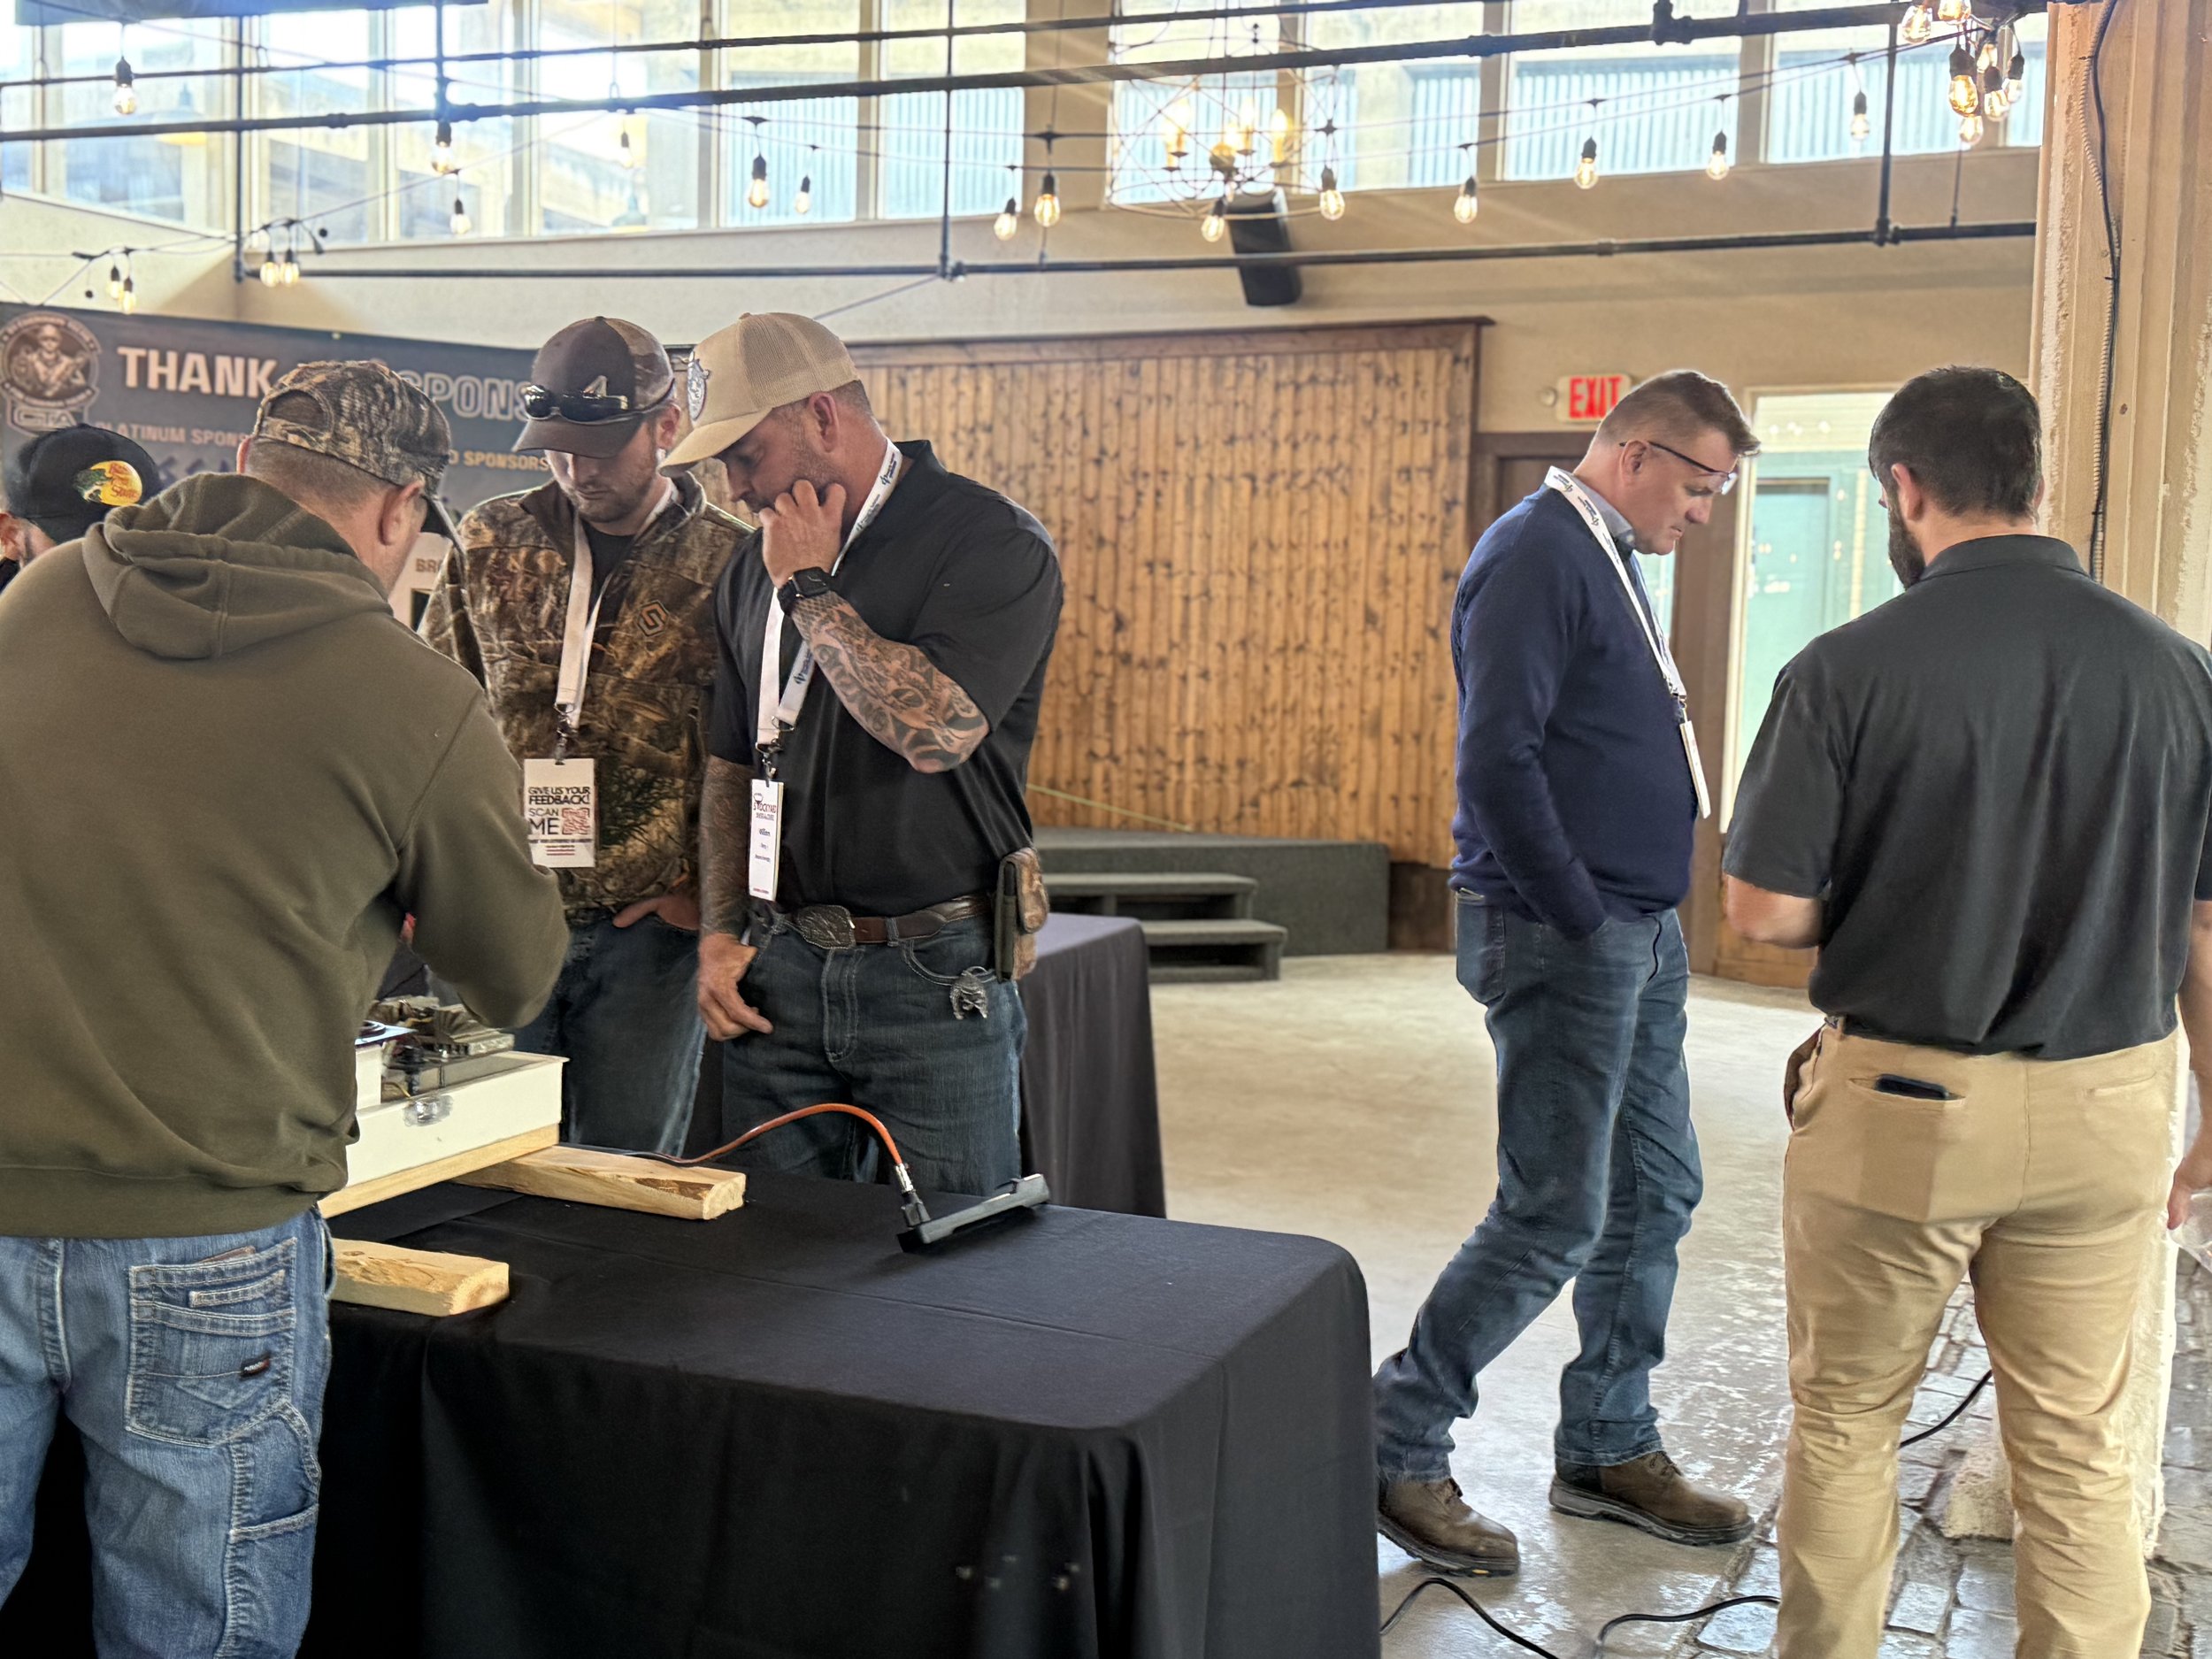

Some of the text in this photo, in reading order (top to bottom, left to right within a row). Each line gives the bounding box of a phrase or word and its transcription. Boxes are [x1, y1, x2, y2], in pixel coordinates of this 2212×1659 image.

[117, 346, 278, 398] THANK
[1569, 374, 1623, 419] EXIT
[529, 808, 559, 817] SCAN
[529, 818, 559, 835] ME
